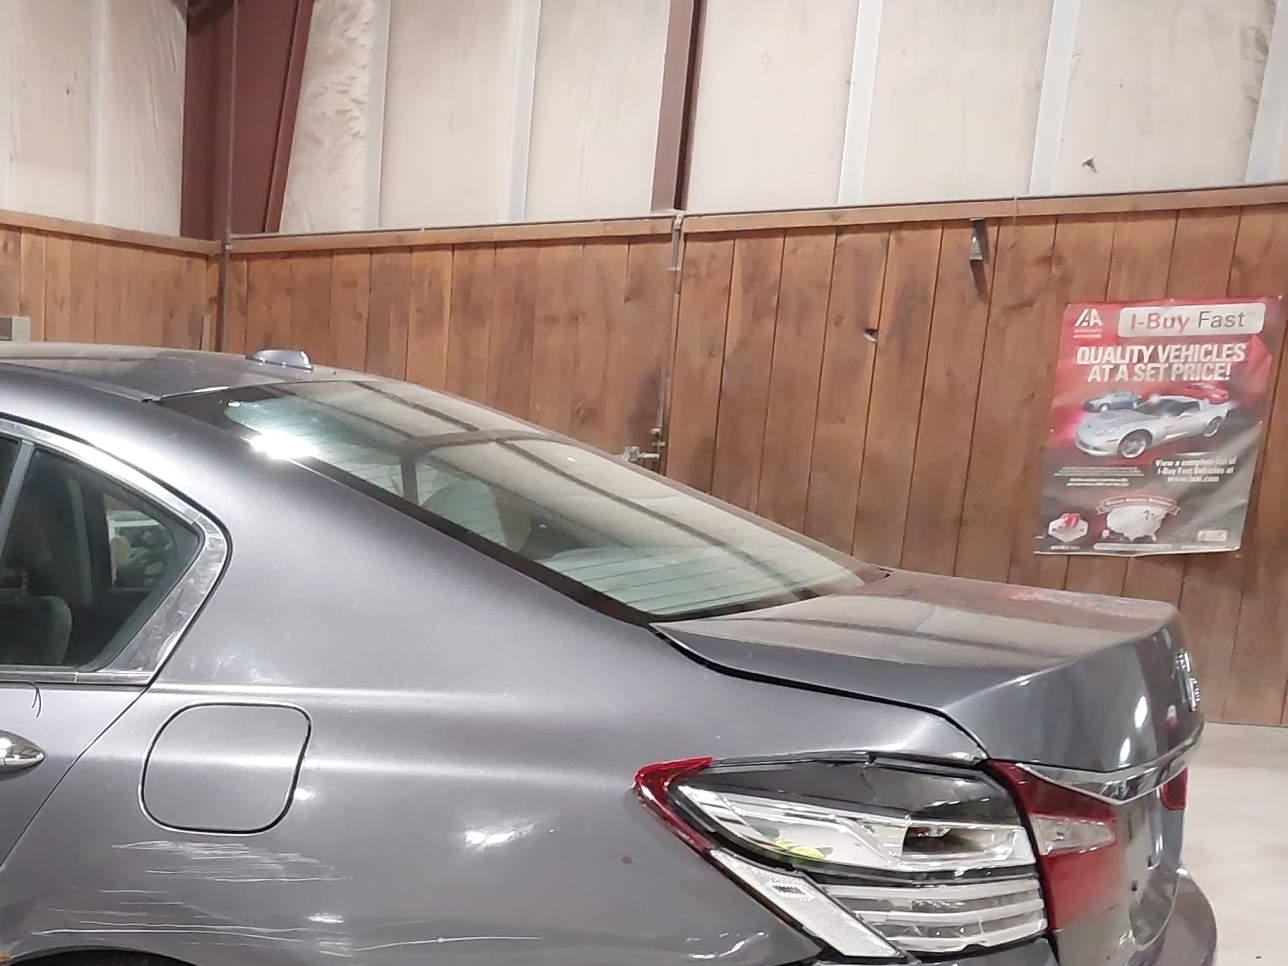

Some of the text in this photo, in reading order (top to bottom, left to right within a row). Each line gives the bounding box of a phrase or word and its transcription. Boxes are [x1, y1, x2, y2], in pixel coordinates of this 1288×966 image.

[1130, 310, 1246, 333] I-Buy Fast
[1076, 343, 1246, 365] QUALITY VEHICLES
[1087, 362, 1231, 382] AT A SET PRICE!
